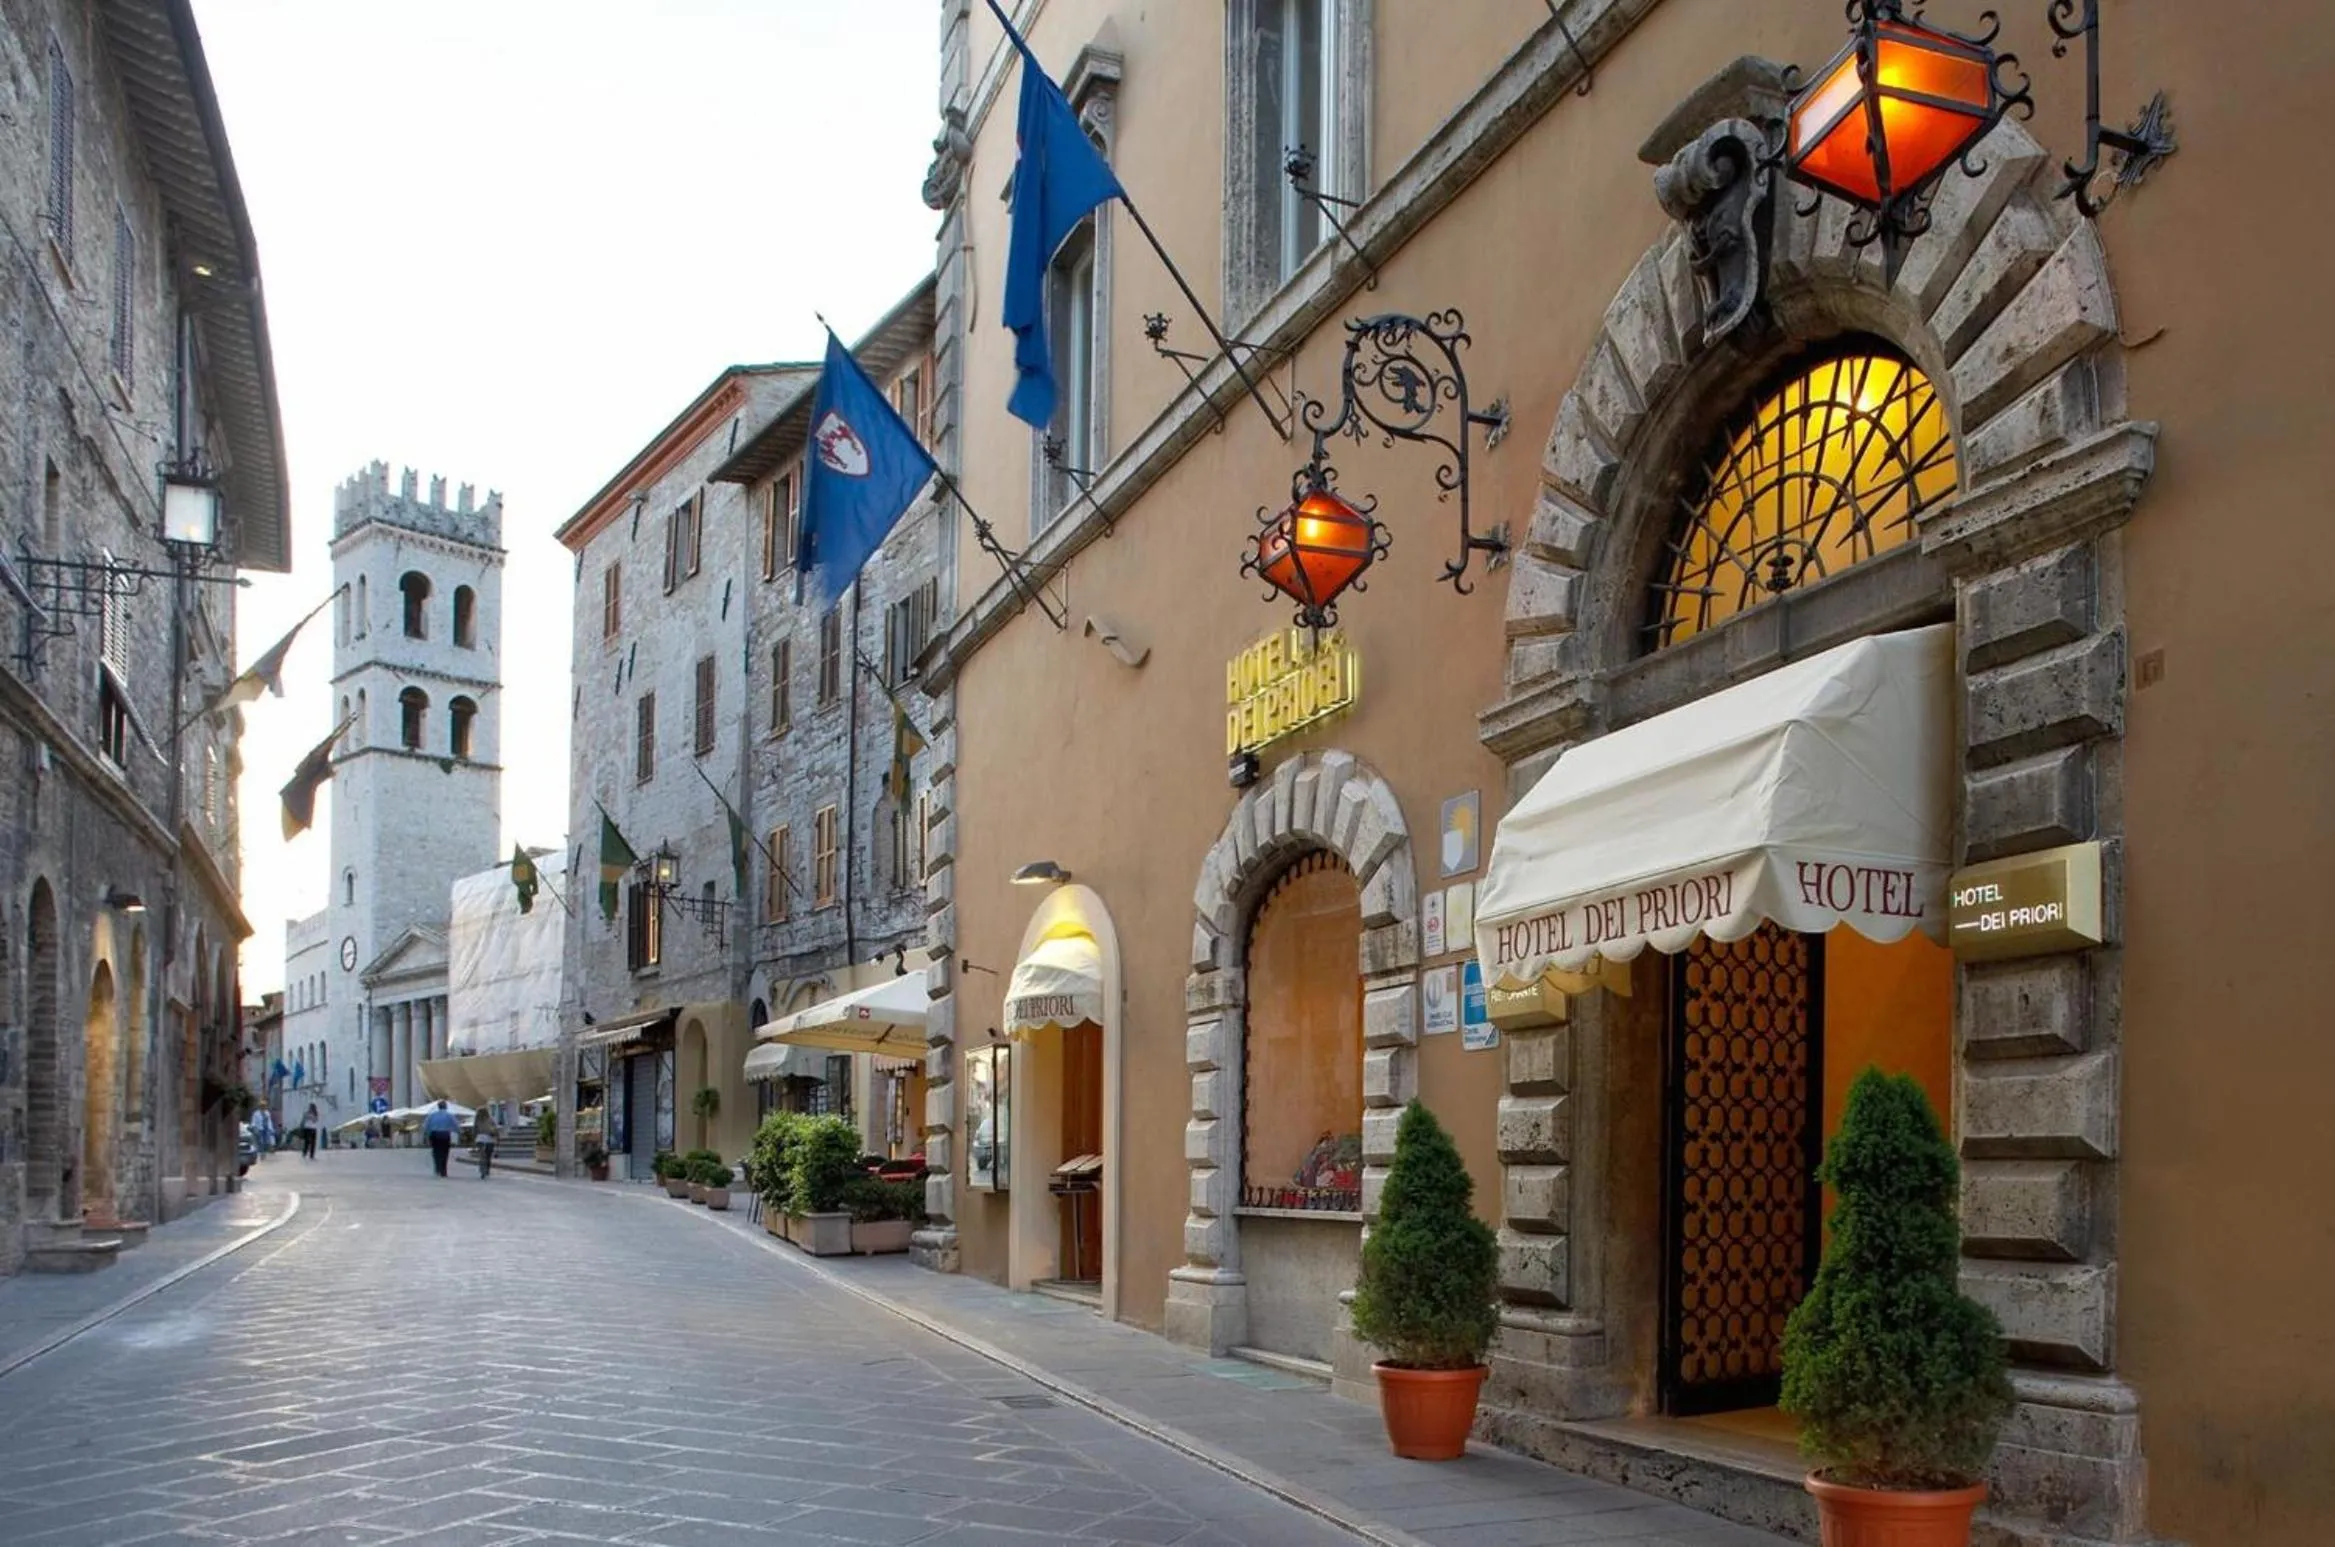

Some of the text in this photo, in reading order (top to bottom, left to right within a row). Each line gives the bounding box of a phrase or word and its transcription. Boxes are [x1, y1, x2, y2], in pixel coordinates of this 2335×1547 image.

[1226, 629, 1299, 704] HOTEL
[1226, 651, 1348, 756] DEI PRIORI
[1796, 861, 1924, 917] HOTEL
[1954, 883, 2003, 908] HOTEL
[2010, 903, 2064, 927] PRIORI
[1496, 911, 1573, 965] HOTEL
[1583, 896, 1627, 945] DEI
[1636, 871, 1734, 934] PRIORI
[1031, 995, 1074, 1018] PRIORI
